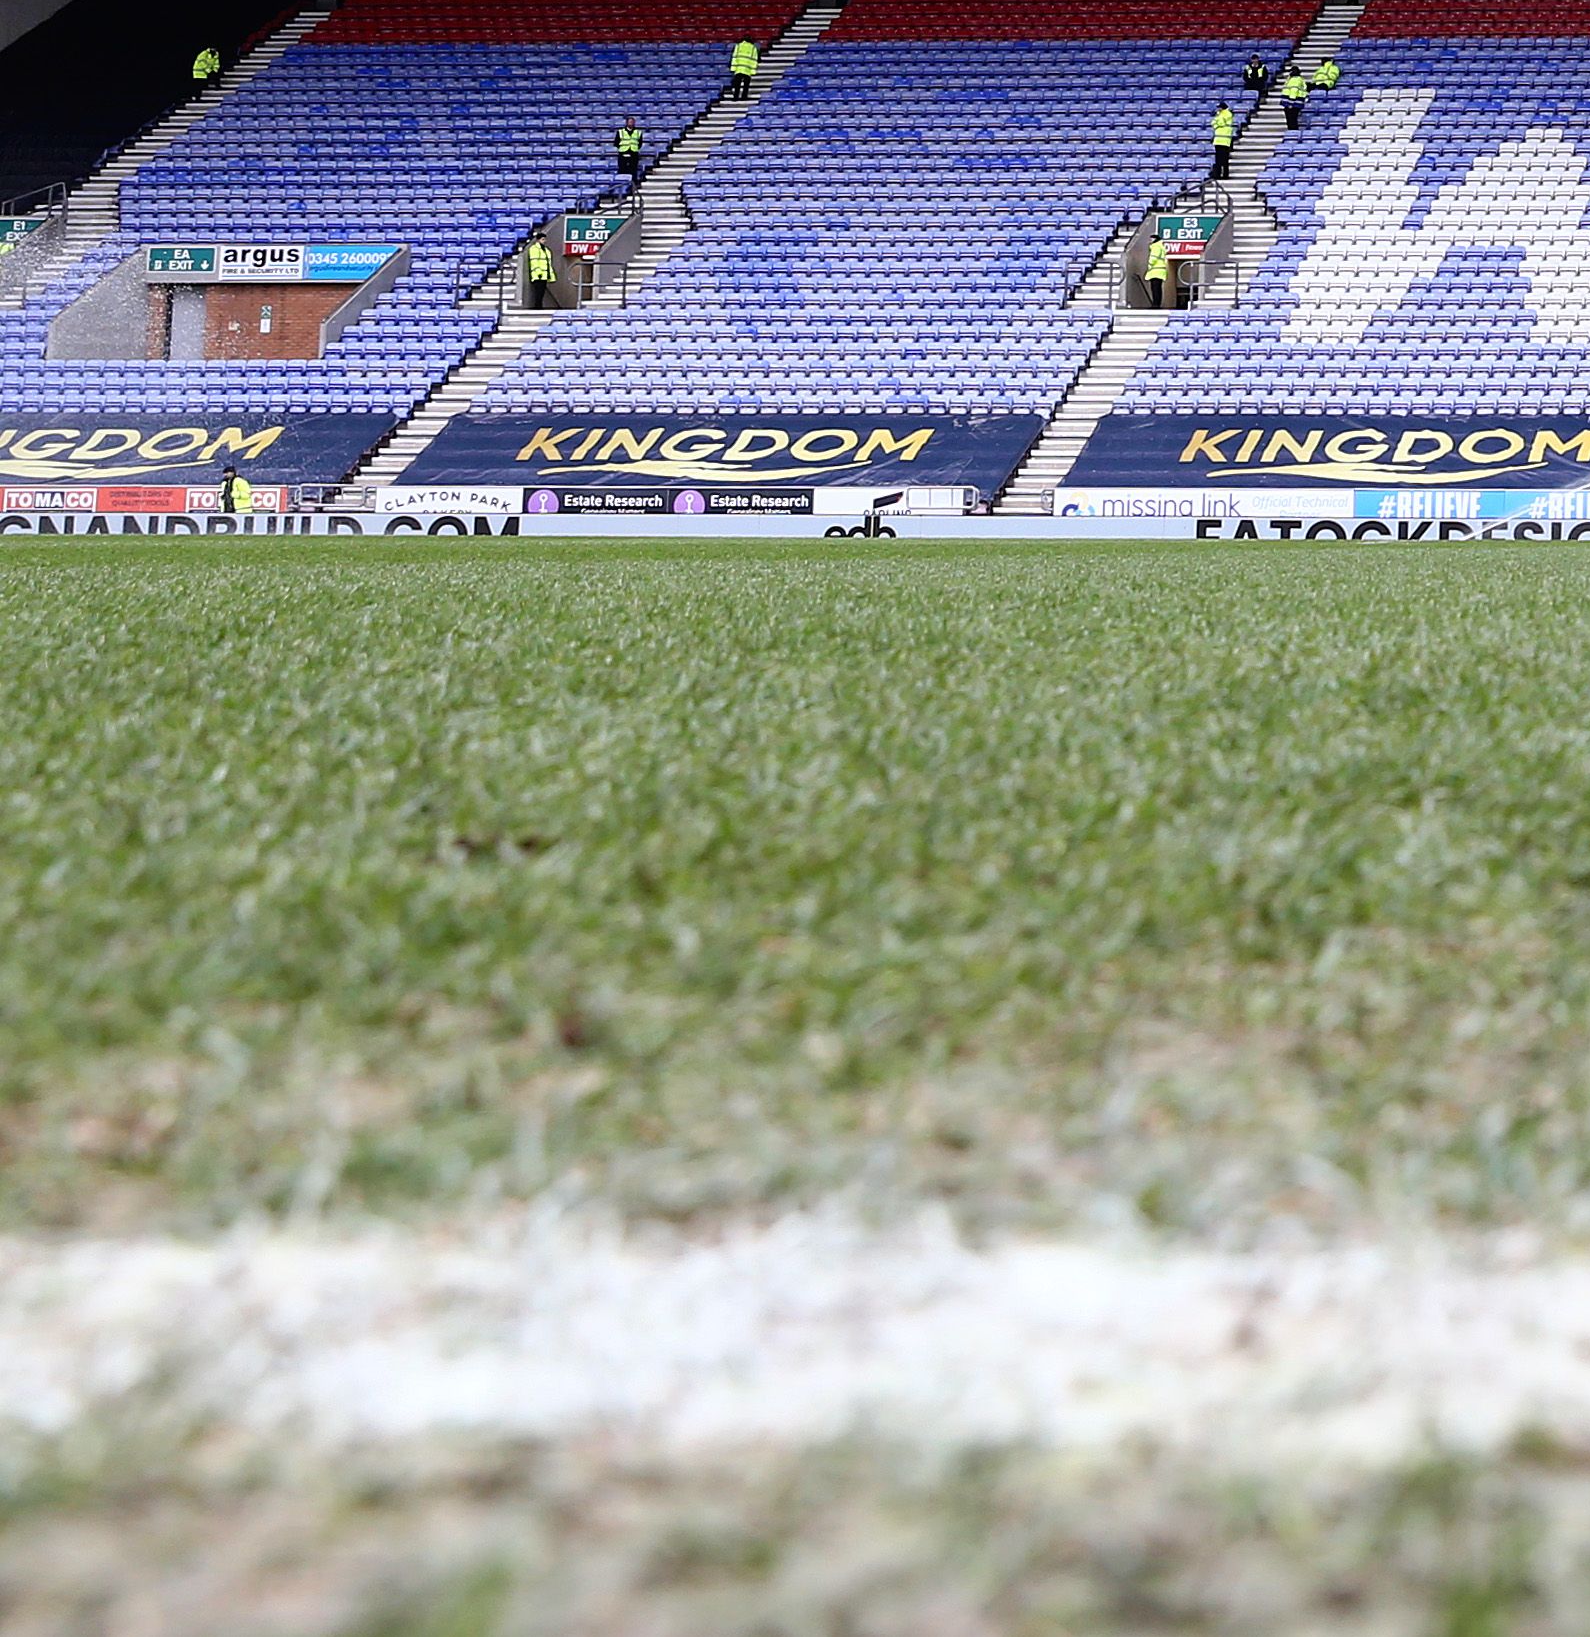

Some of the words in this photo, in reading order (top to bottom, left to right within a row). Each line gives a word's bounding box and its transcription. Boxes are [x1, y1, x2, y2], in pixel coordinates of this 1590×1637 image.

[585, 230, 611, 240] EXIT
[1177, 229, 1204, 239] EXIT
[174, 250, 191, 259] EA
[571, 243, 589, 253] DW
[223, 248, 300, 268] argus
[169, 260, 194, 270] EXIT
[515, 427, 935, 461] KINGDOM
[8, 492, 93, 508] TOMACO
[190, 492, 276, 508] TOCO
[384, 491, 461, 511] CLAYTON
[470, 493, 512, 512] PARK
[564, 494, 603, 507] Estate
[605, 494, 663, 507] Research
[710, 494, 749, 507] Estate
[751, 494, 809, 507] Research
[1202, 493, 1241, 517] link
